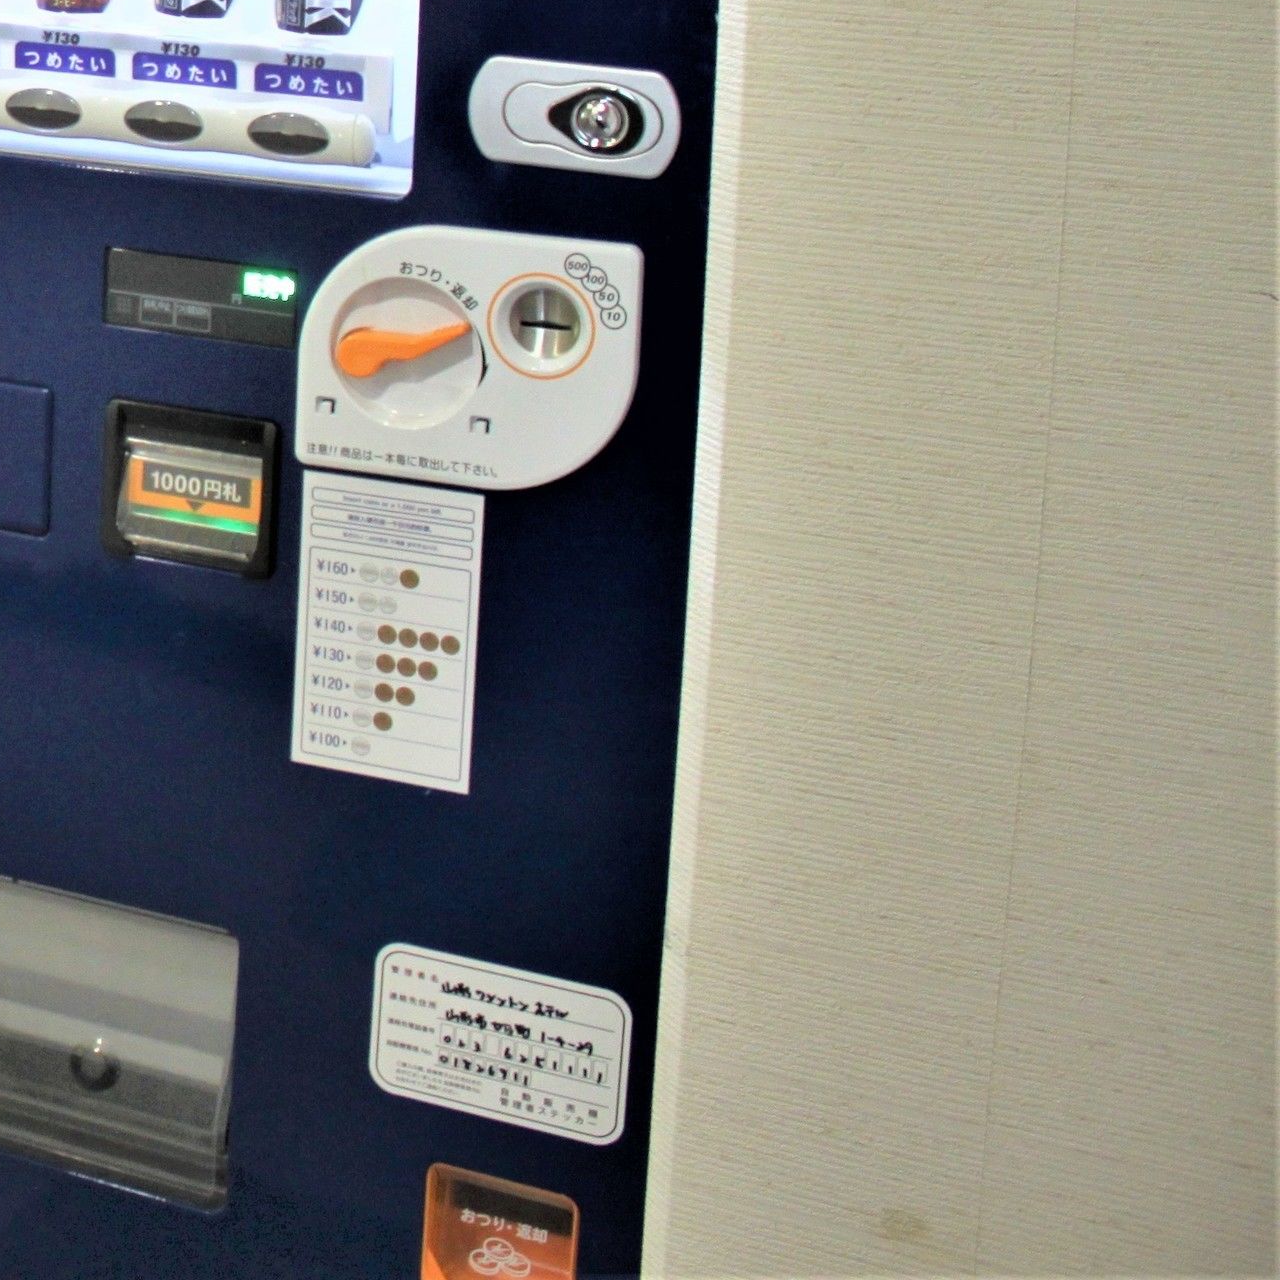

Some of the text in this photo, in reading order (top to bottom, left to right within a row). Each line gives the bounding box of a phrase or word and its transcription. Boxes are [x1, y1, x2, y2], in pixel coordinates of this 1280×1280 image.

[43, 31, 80, 45] ¥130
[161, 42, 200, 57] ¥130
[24, 50, 106, 71] つめたい
[285, 54, 325, 69] ¥130
[142, 61, 228, 84] つめたい
[265, 72, 354, 96] つめたい
[151, 468, 242, 504] 1000円札
[316, 558, 349, 576] ¥160
[314, 587, 347, 604] ¥150
[313, 616, 346, 633] ¥140
[312, 645, 344, 662] ¥130
[311, 674, 343, 691] ¥120
[310, 702, 341, 719] ¥110
[308, 730, 340, 747] ¥100
